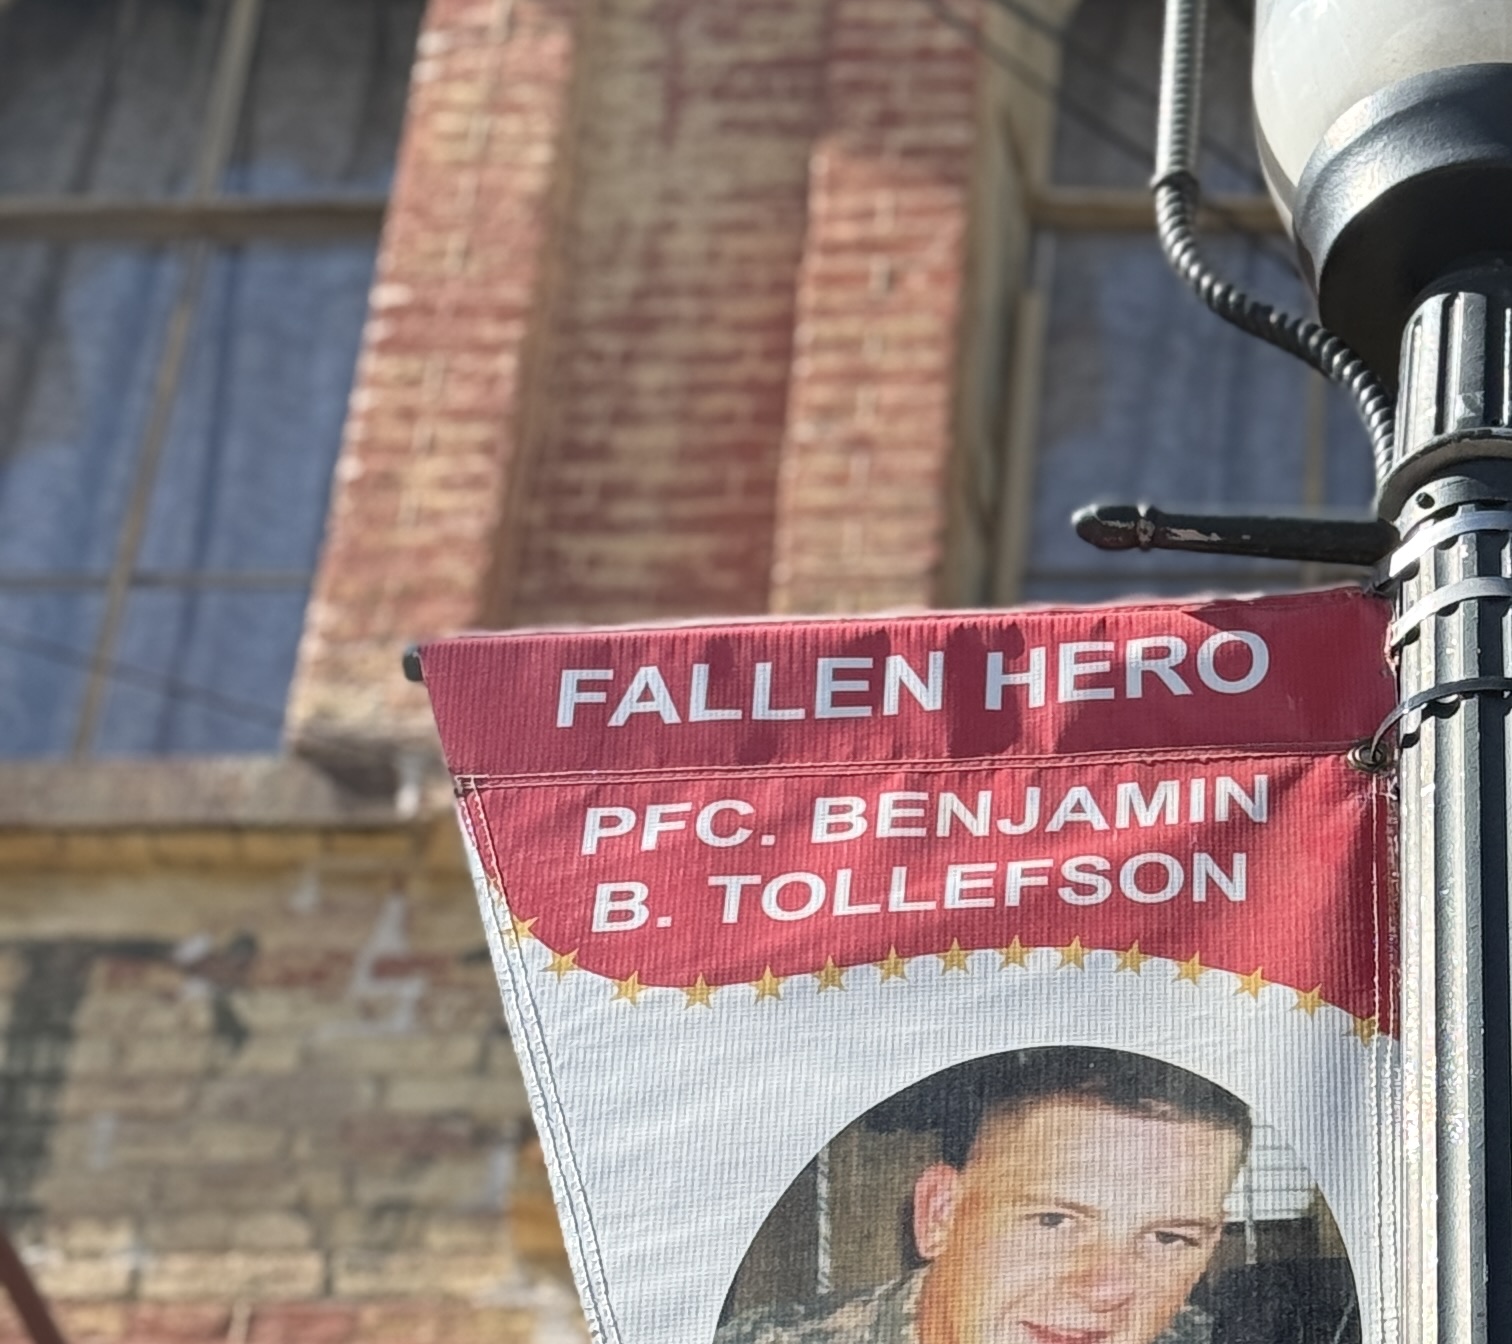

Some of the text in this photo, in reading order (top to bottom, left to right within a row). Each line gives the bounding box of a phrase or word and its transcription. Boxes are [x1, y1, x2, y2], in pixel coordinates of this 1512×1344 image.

[555, 629, 1271, 730] FALLEN HERO
[580, 773, 1270, 856] PFC. BENJAMIN
[590, 851, 1249, 934] B. TOLLEFSON
